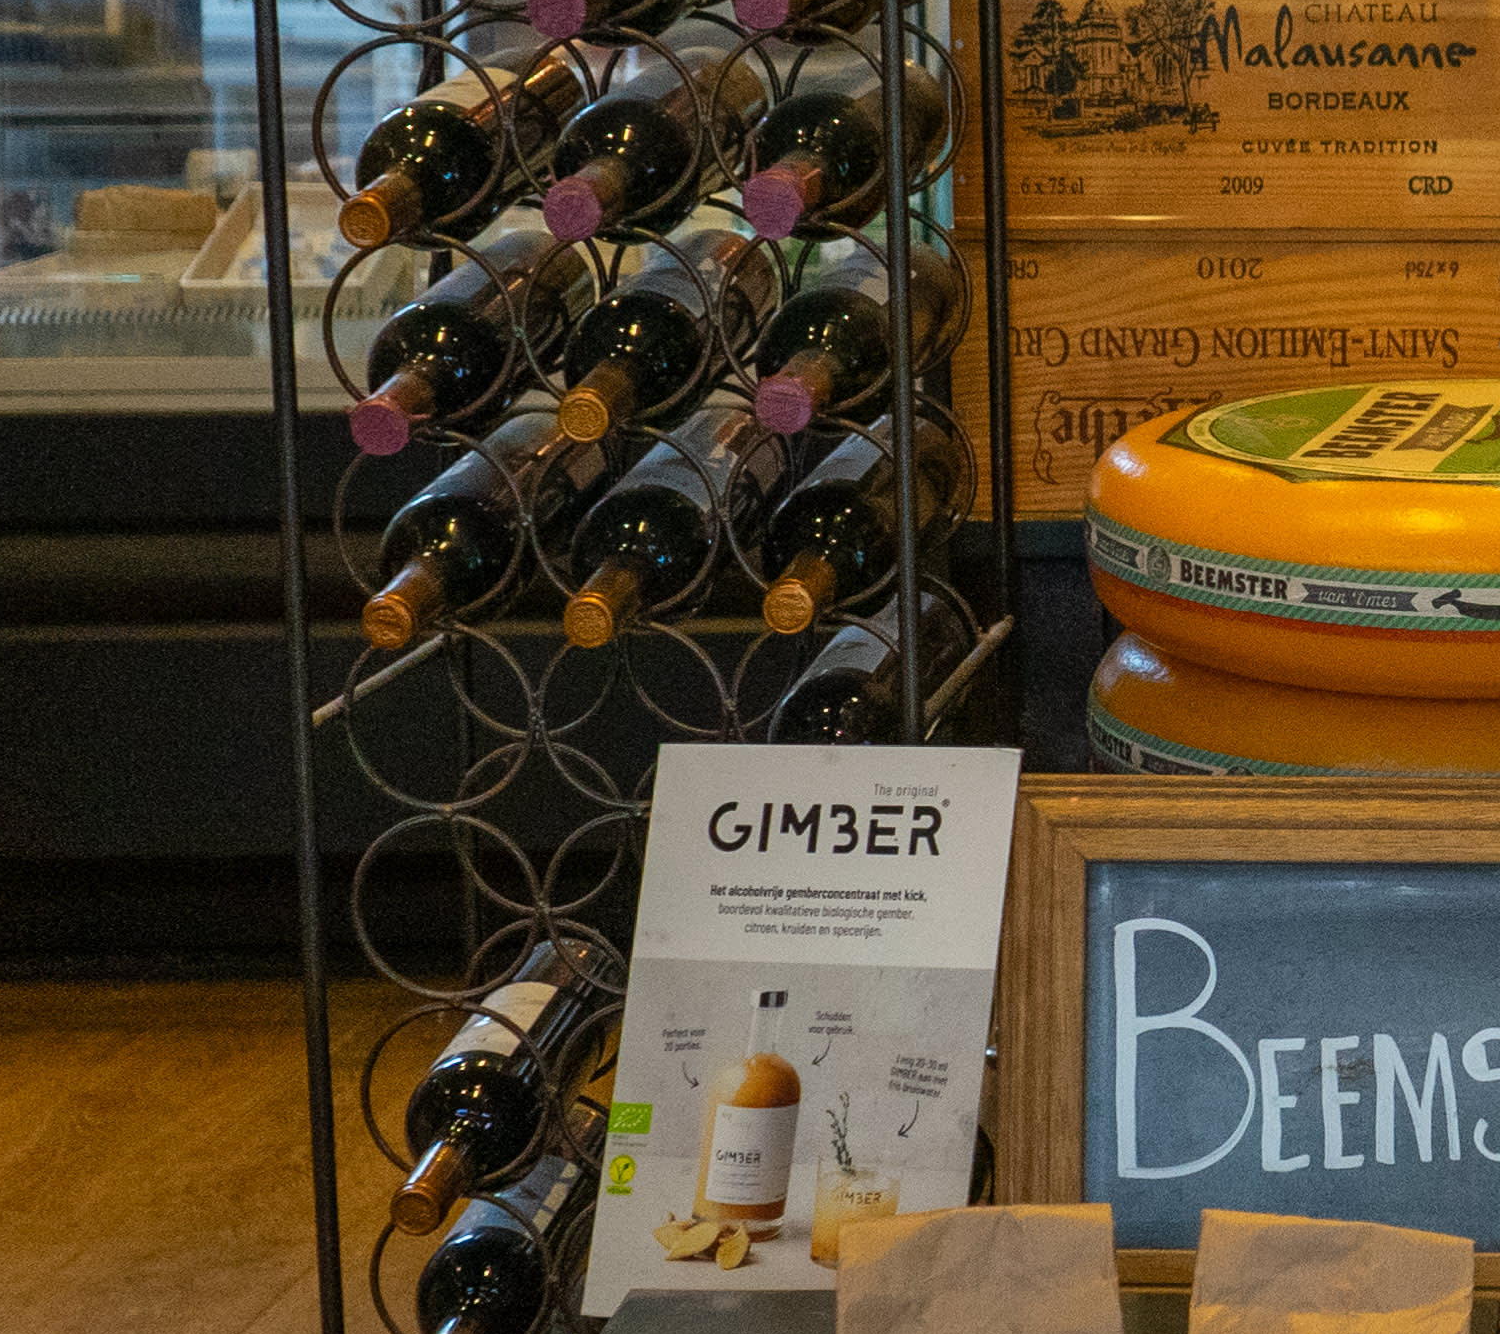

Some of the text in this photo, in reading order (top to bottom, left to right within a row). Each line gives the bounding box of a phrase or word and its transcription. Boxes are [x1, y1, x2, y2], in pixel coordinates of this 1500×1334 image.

[1304, 3, 1439, 24] CHATEAU
[1199, 5, 1477, 73] Malausanne
[1268, 91, 1410, 111] BORDEAUX
[1241, 137, 1439, 155] CUVÉE TRADITION
[1020, 176, 1086, 195] 6 x 75 cl
[1220, 176, 1265, 195] 2009
[1407, 175, 1454, 195] CRD
[1197, 257, 1263, 280] 2010
[1080, 326, 1201, 368] GRAND
[1211, 327, 1460, 368] SAINT-EMILION
[1301, 391, 1444, 460] BEEMSTER
[1180, 559, 1290, 601] BEEMSTER
[1317, 589, 1346, 605] van
[874, 783, 940, 800] The original
[710, 884, 726, 897] Het
[728, 885, 784, 900] alcoholvrije
[786, 888, 880, 902] gemberconcentraat
[882, 890, 902, 902] met
[718, 902, 764, 915] boordevol
[764, 904, 821, 917] kwalitatieve
[822, 905, 875, 919] biologische
[781, 924, 816, 935] kruiden
[818, 926, 831, 935] en
